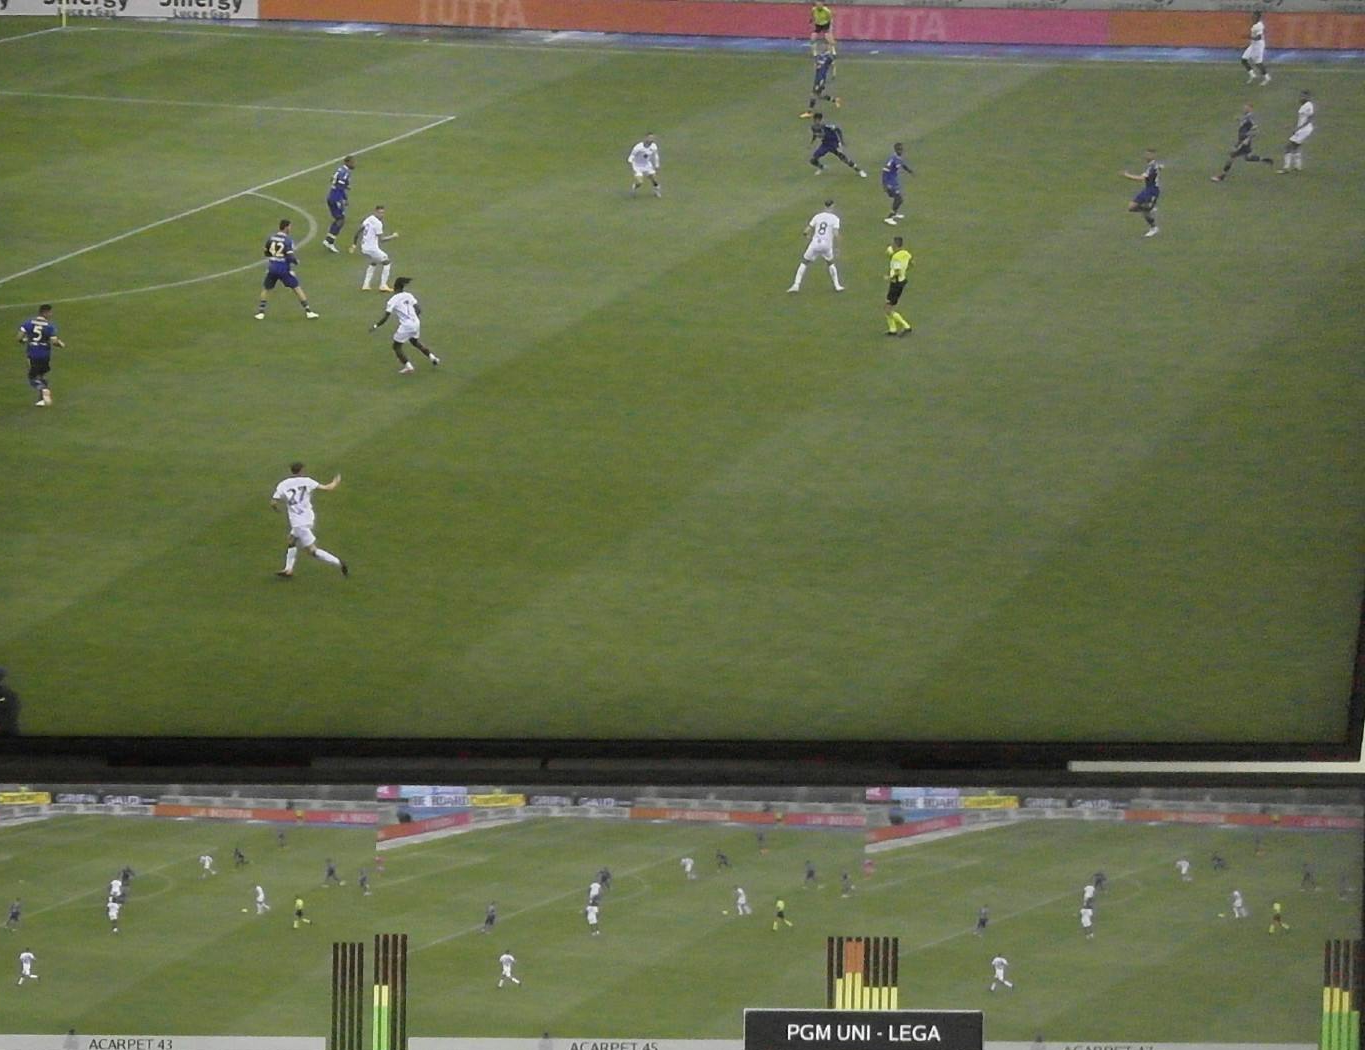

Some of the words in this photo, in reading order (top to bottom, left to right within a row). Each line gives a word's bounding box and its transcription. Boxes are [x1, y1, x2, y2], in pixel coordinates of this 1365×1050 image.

[269, 241, 285, 257] 42
[287, 485, 307, 506] 27
[787, 1024, 831, 1041] PGM
[837, 1026, 871, 1041] UNI
[888, 1025, 941, 1042] LEGA
[89, 1038, 153, 1050] ACARPET
[157, 1038, 172, 1050] 43
